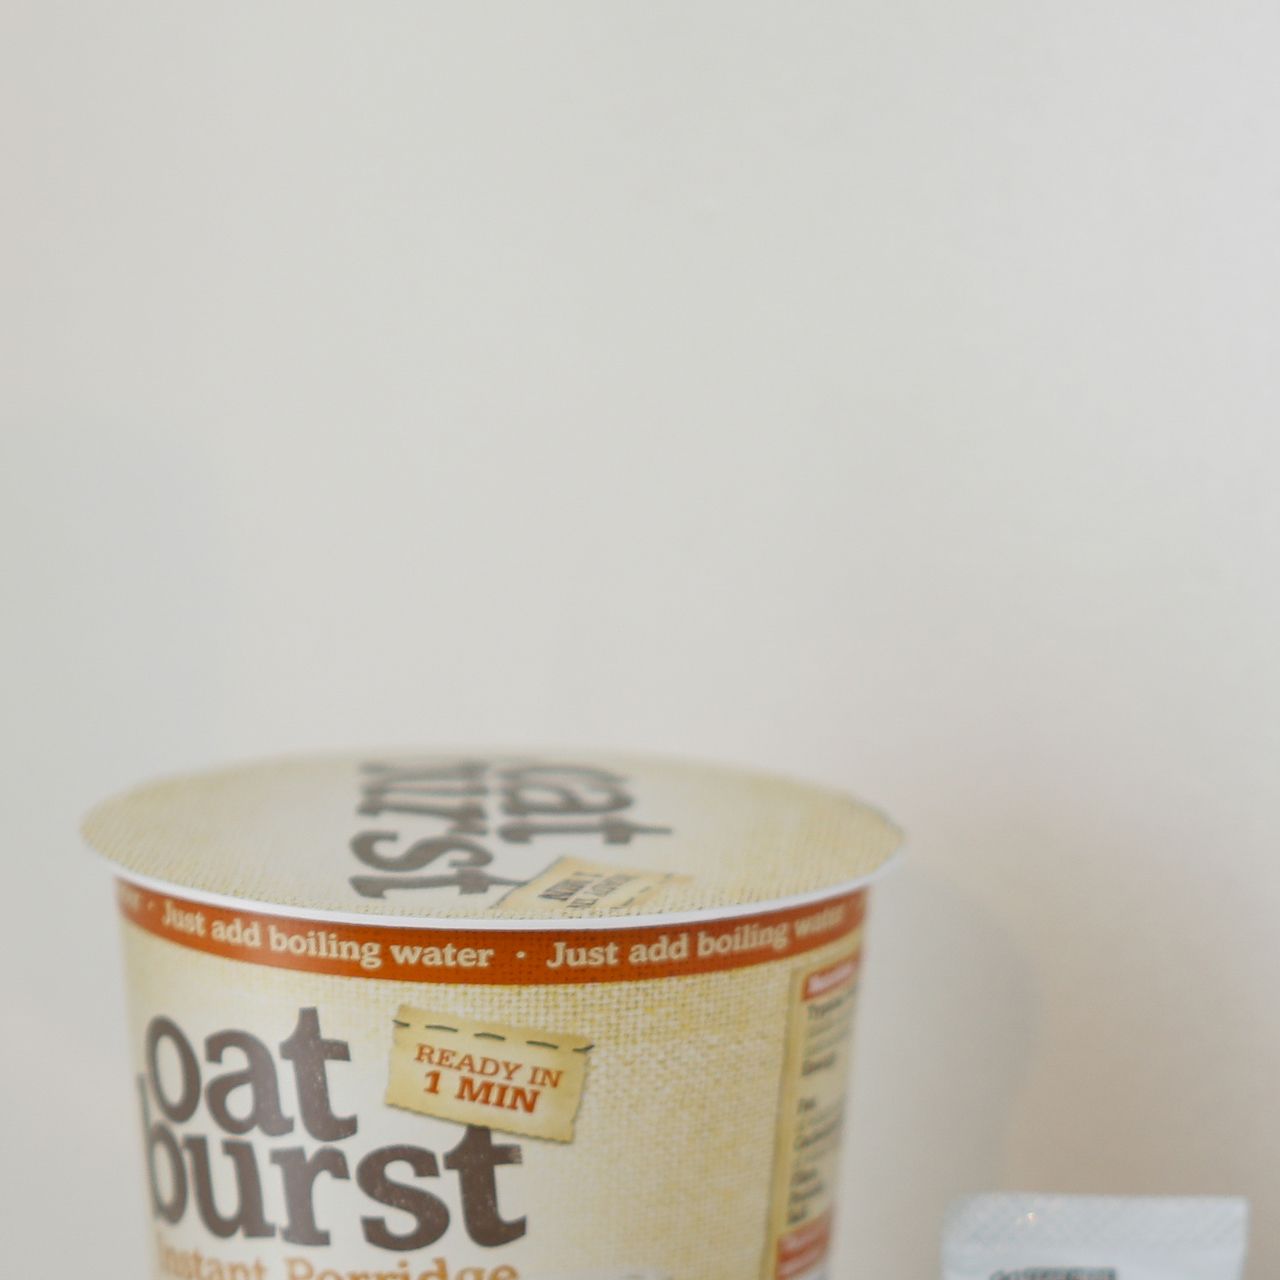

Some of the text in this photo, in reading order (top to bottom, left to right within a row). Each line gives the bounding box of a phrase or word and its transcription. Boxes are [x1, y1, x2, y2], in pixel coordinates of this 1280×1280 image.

[161, 901, 495, 970] Just add boiling water
[545, 942, 619, 970] Just
[628, 933, 689, 965] add
[696, 921, 790, 956] boiling
[145, 1006, 358, 1143] oat
[413, 1043, 564, 1090] READY IN
[423, 1070, 542, 1115] 1 MIN
[138, 1071, 528, 1252] burst
